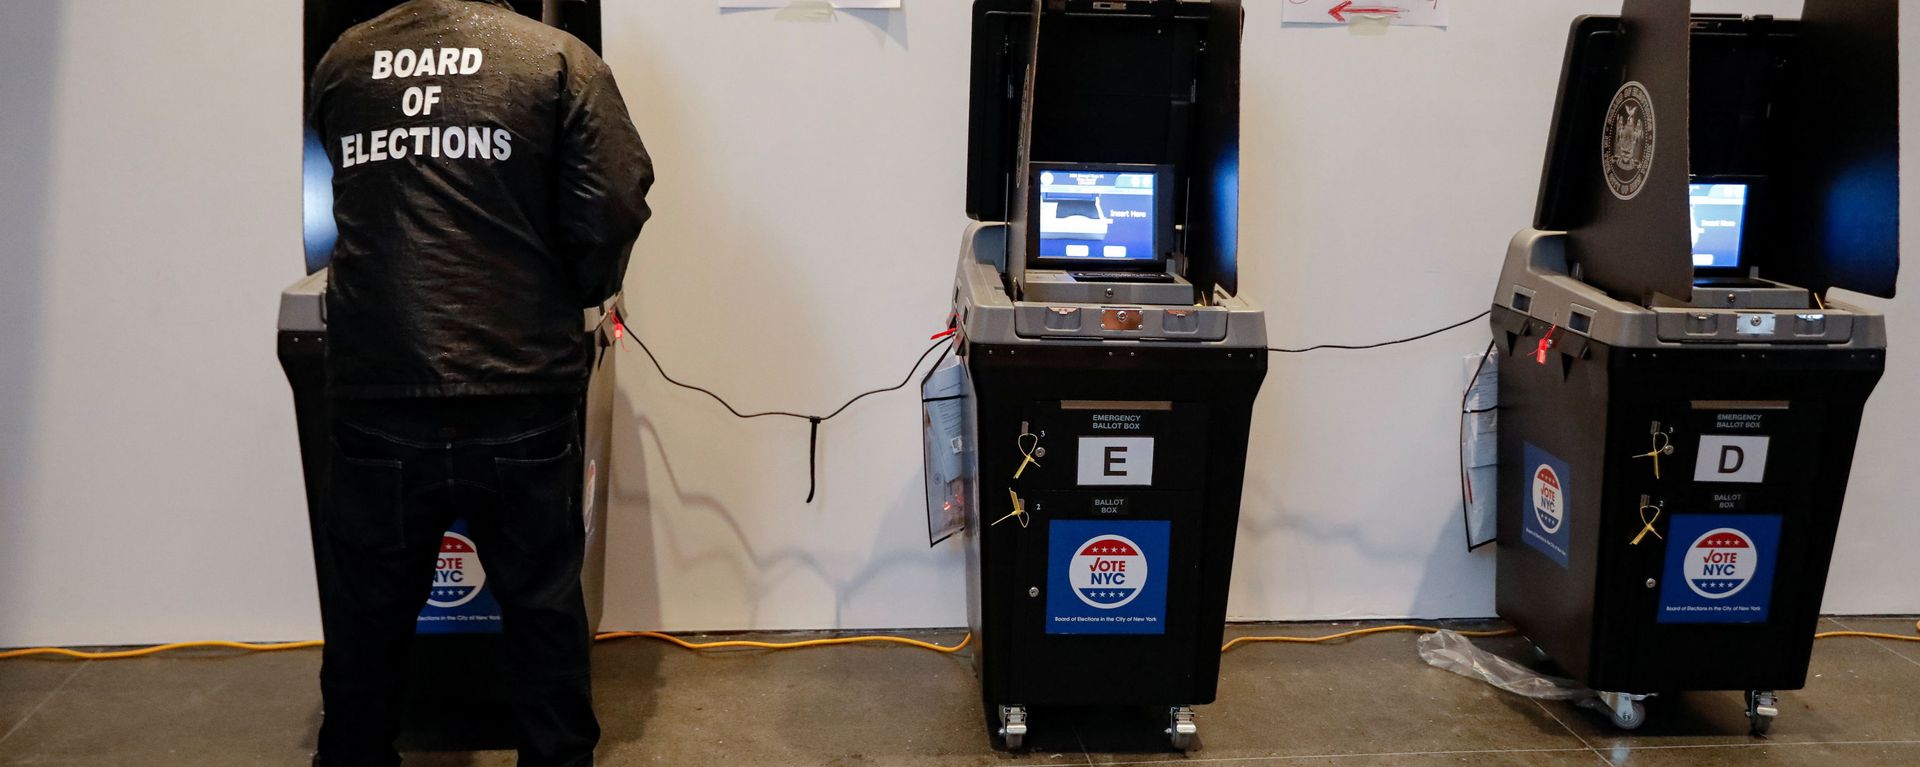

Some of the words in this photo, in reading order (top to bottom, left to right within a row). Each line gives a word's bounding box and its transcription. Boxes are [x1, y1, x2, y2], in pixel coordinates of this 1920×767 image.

[372, 48, 482, 80] BOARD
[402, 86, 442, 116] OF
[341, 126, 512, 168] ELECTIONS
[1104, 446, 1128, 476] E
[1718, 445, 1744, 474] D
[1541, 496, 1555, 513] NYC
[436, 558, 463, 569] OTE
[1703, 564, 1735, 575] NYC
[1091, 573, 1125, 585] NYC
